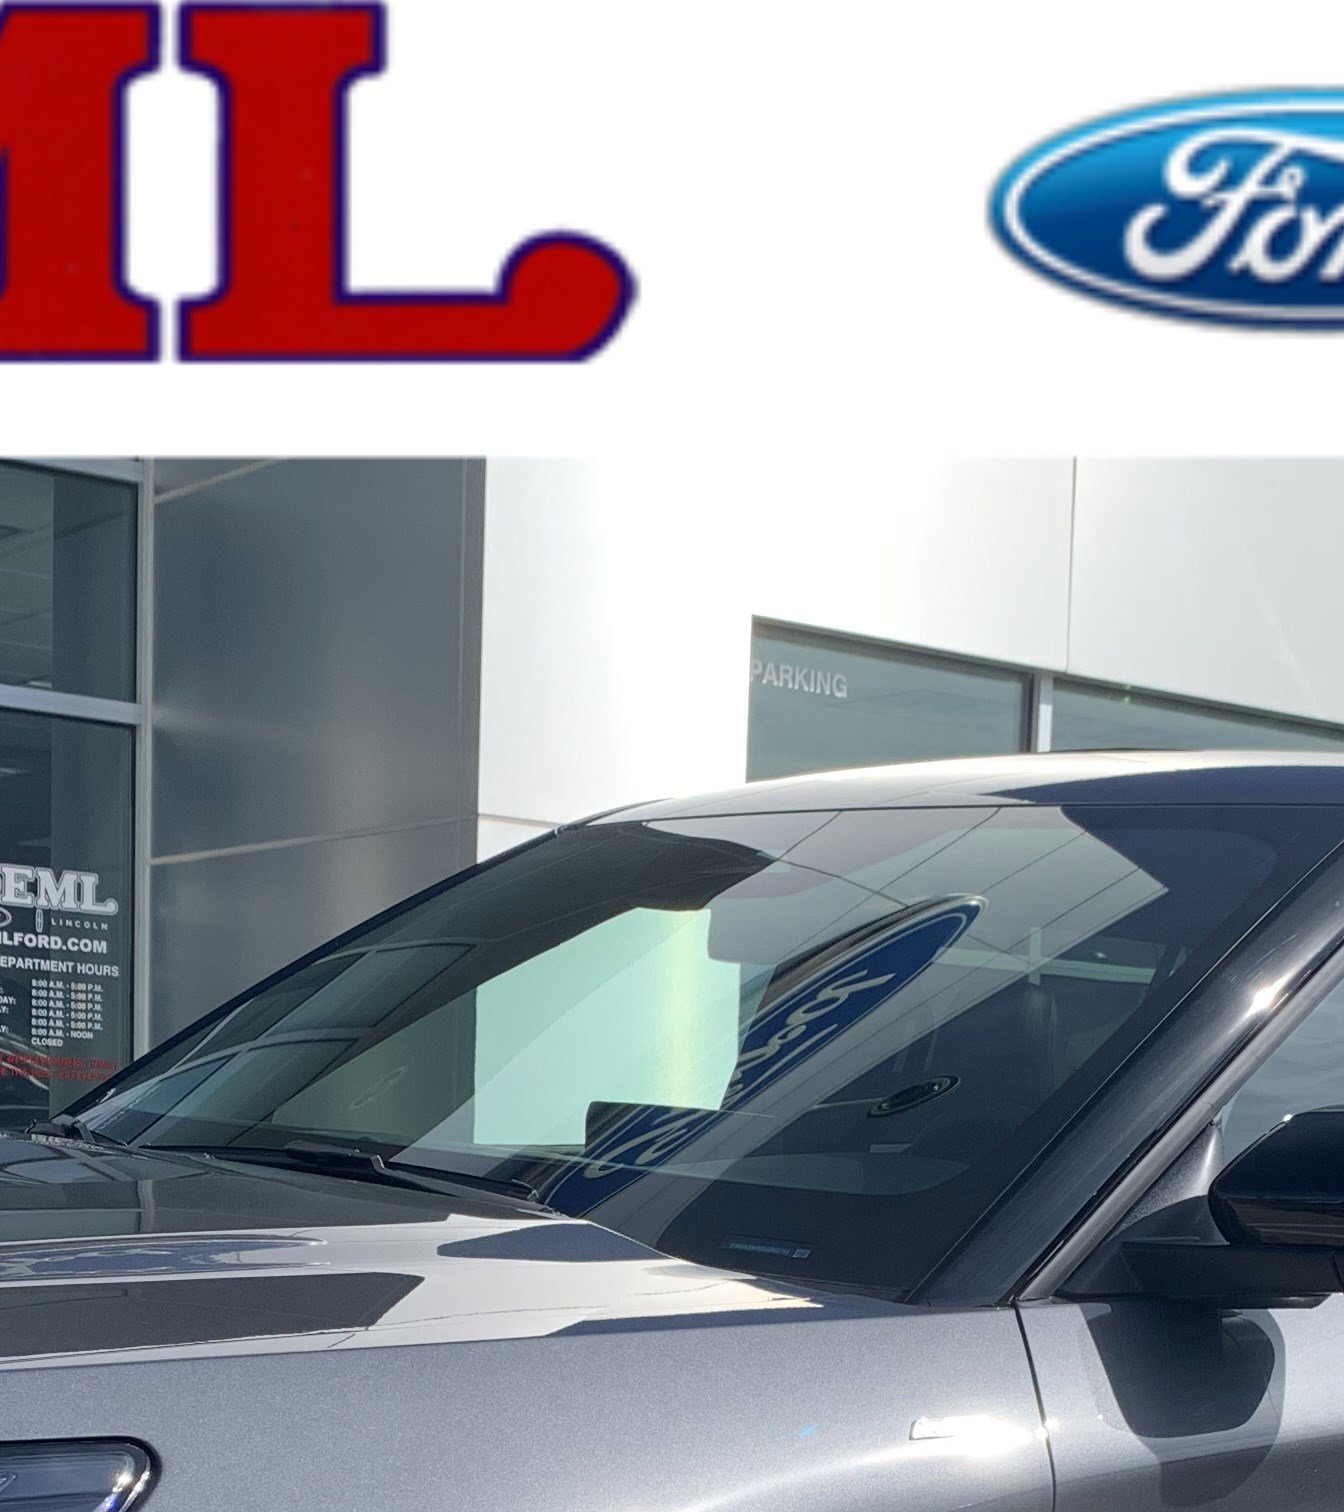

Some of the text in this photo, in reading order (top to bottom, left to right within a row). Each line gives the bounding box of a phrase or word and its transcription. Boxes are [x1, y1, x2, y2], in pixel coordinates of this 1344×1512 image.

[750, 659, 847, 698] PARKING
[51, 917, 109, 931] LINCOLN
[77, 964, 119, 977] HOURS
[71, 1030, 93, 1039] NOON
[31, 1037, 63, 1047] CLOSED
